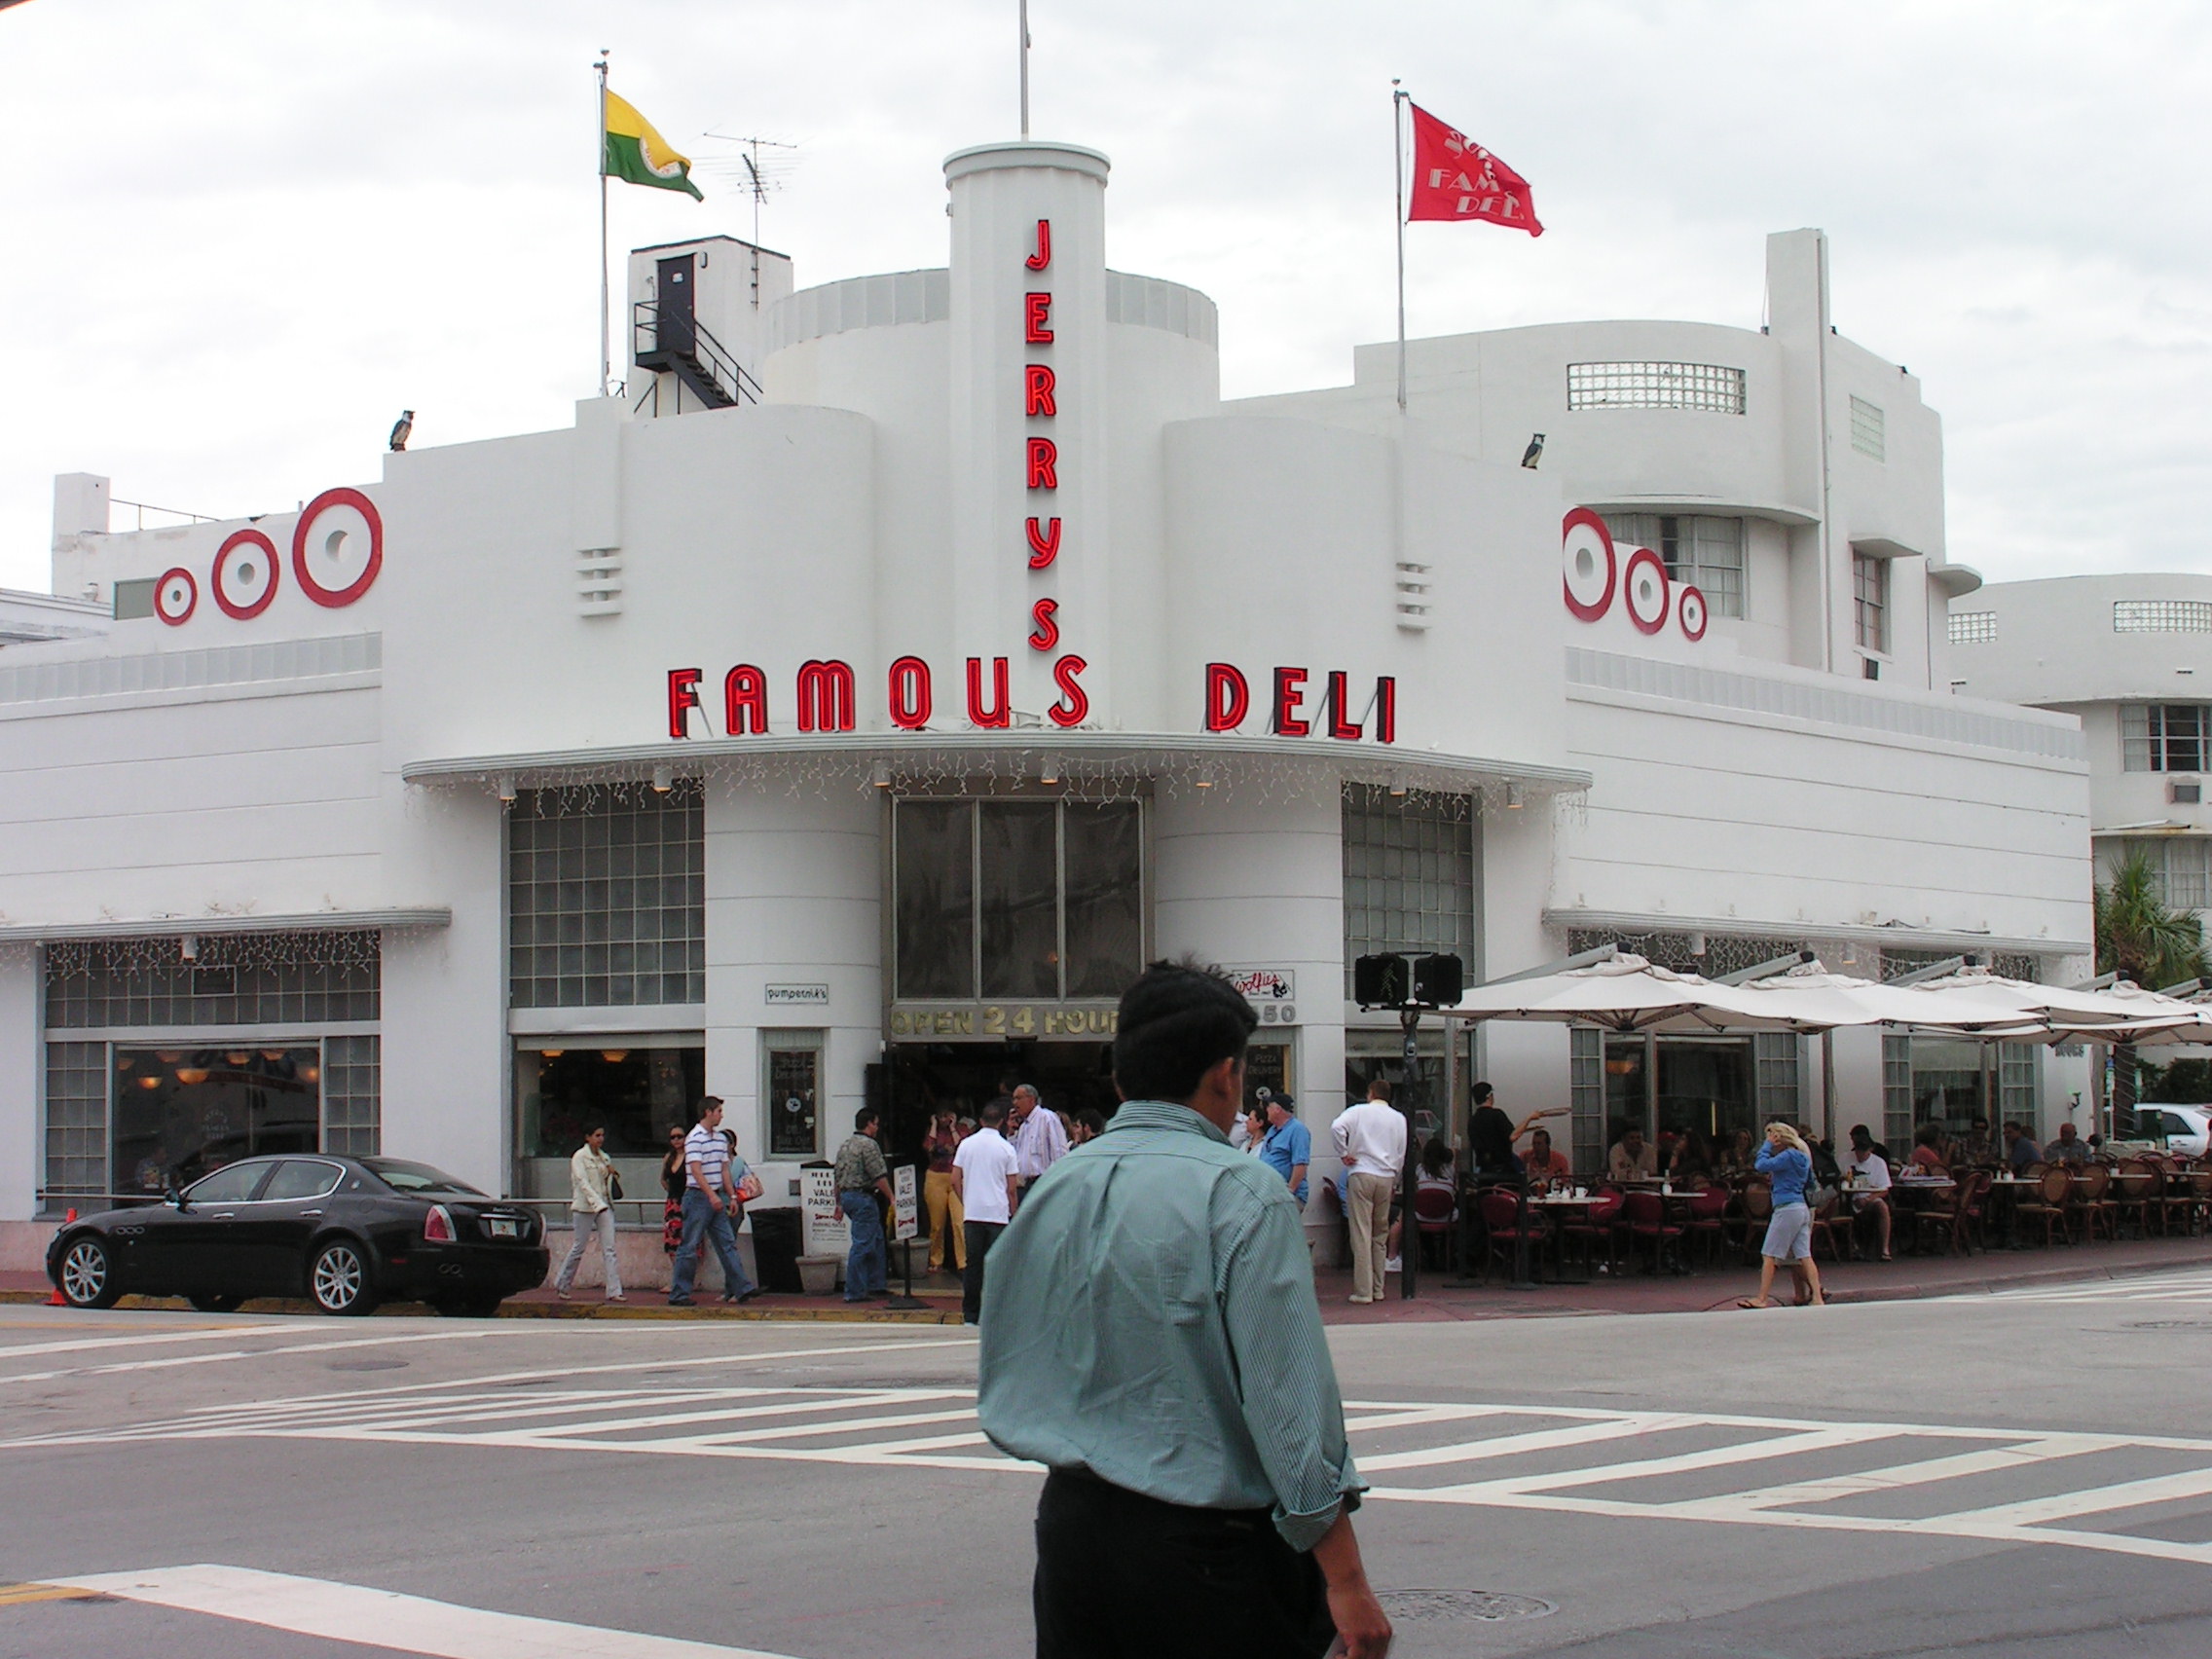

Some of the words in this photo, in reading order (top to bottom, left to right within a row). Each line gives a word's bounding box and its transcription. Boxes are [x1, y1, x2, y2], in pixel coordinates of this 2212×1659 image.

[1025, 219, 1061, 651] JERRYS
[667, 654, 1088, 738] FAMOUS
[1204, 662, 1395, 743] DELI
[890, 1010, 974, 1035] OPEN
[982, 1006, 1035, 1035] 24
[1252, 1005, 1296, 1022] 50
